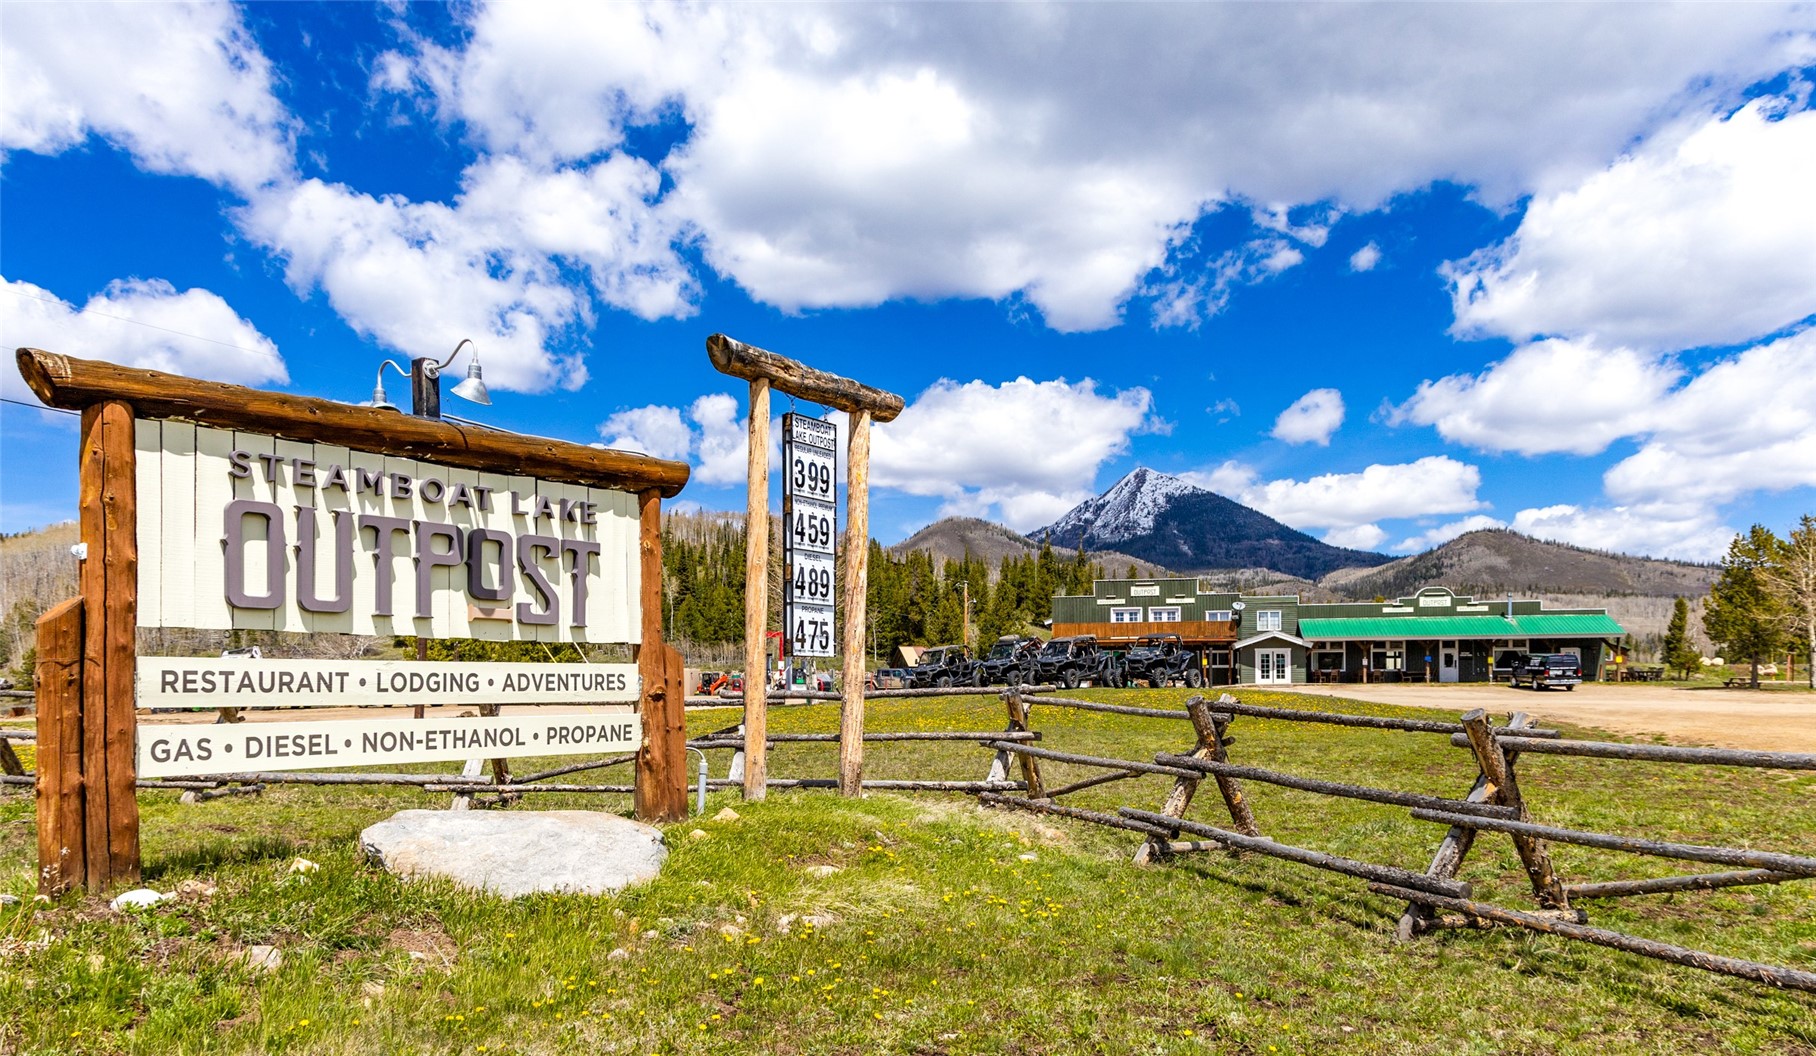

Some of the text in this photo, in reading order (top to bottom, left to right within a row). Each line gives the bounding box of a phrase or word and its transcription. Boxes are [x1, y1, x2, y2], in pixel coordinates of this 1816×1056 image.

[795, 417, 831, 436] STEAMBOAT
[809, 433, 834, 448] OUTPOST
[228, 449, 597, 525] STEAMBOAT LAKE
[795, 458, 830, 494] 399
[795, 512, 830, 546] 459
[220, 499, 600, 628] OUTPOST
[804, 553, 821, 562] DIESEL
[795, 566, 830, 598] 489
[801, 605, 824, 615] PROPANE
[795, 619, 830, 650] 475
[161, 670, 626, 694] RESTAURANT LODGING ADVENTURES
[150, 723, 633, 763] GAS DIESEL NON-ETHANOL PROPANE
